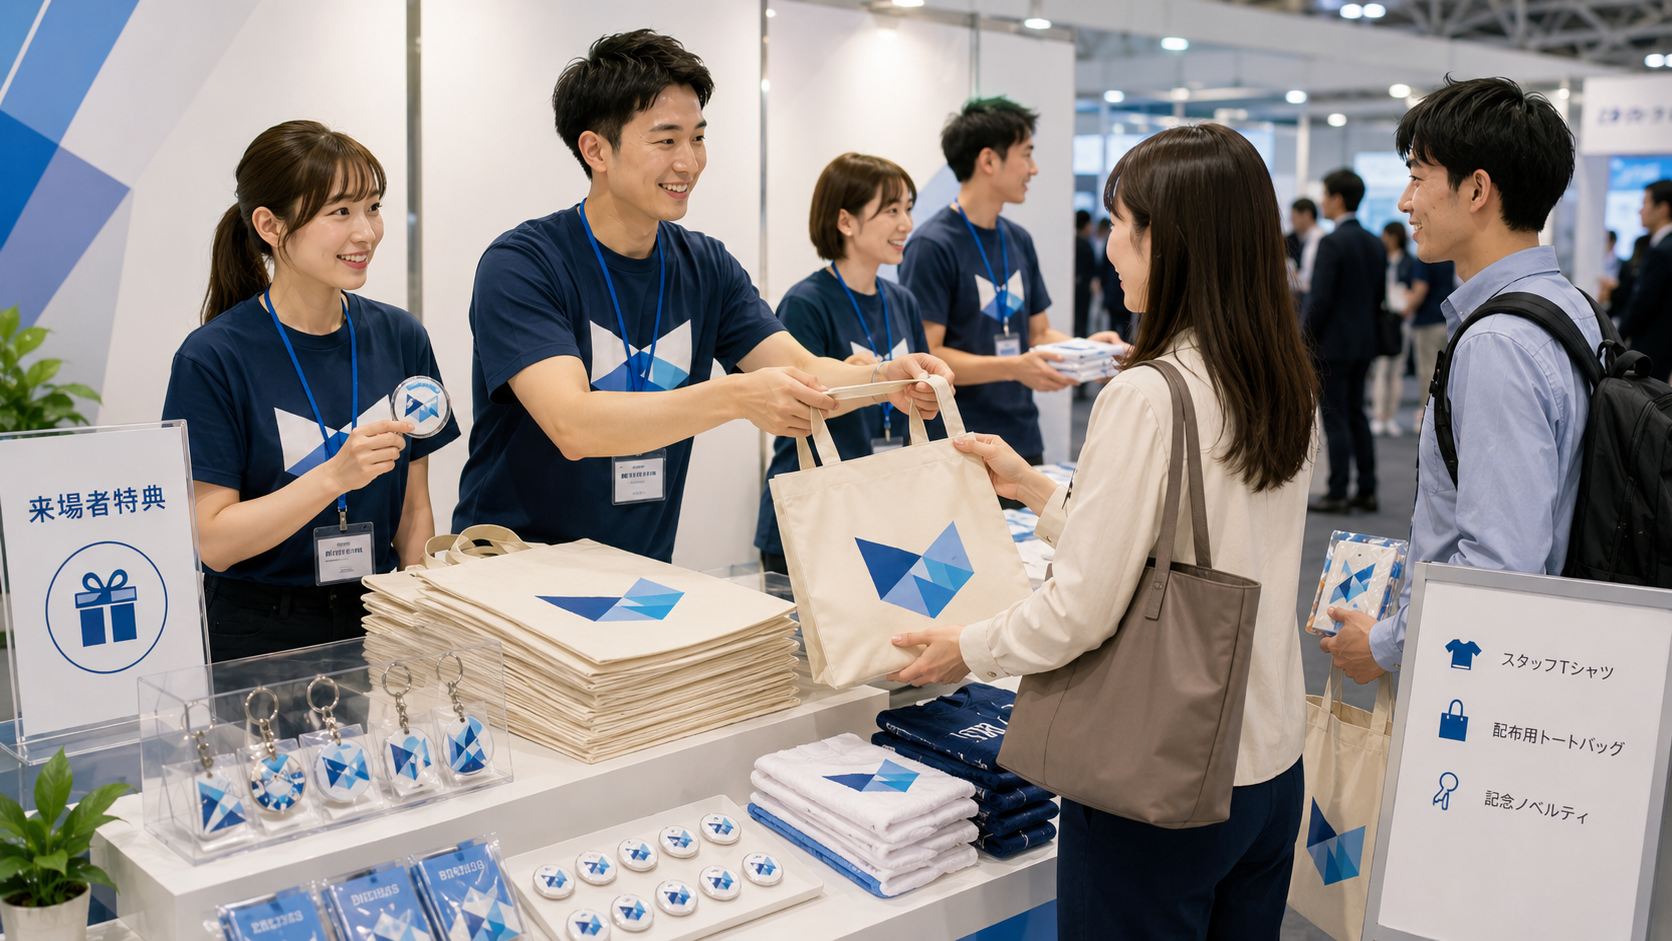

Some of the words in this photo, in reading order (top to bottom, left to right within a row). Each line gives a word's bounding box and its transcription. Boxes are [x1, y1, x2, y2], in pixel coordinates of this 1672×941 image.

[29, 484, 166, 524] 来場者特典
[1501, 652, 1614, 680] スタッフTシャツ
[1492, 722, 1626, 757] 配布用トートバッグ
[1484, 790, 1589, 825] 記念ノベルティ
